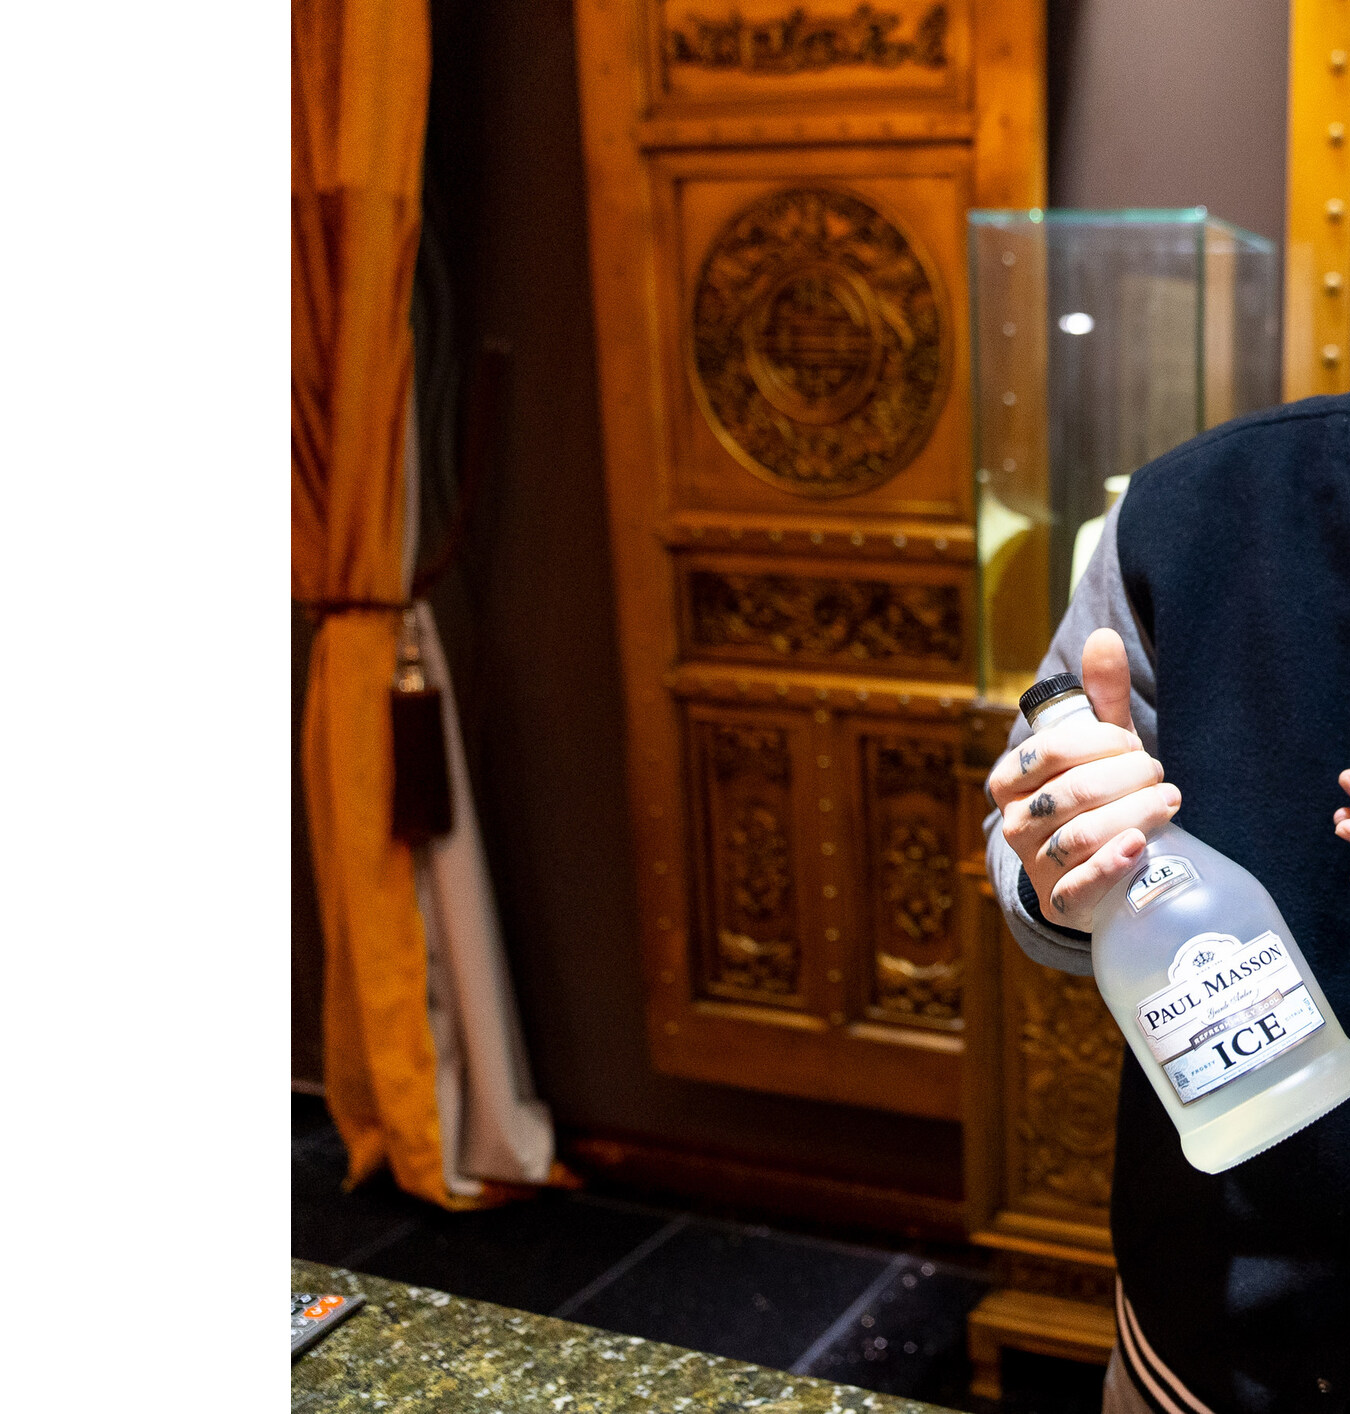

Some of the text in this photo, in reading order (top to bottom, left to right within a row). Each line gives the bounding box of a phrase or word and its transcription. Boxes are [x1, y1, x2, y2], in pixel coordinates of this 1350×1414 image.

[1140, 866, 1173, 888] ICE
[1144, 944, 1282, 1031] PAUL MASSON
[1259, 996, 1280, 1012] COOL
[1191, 1060, 1215, 1076] FROSTY
[1212, 1012, 1287, 1070] ICE
